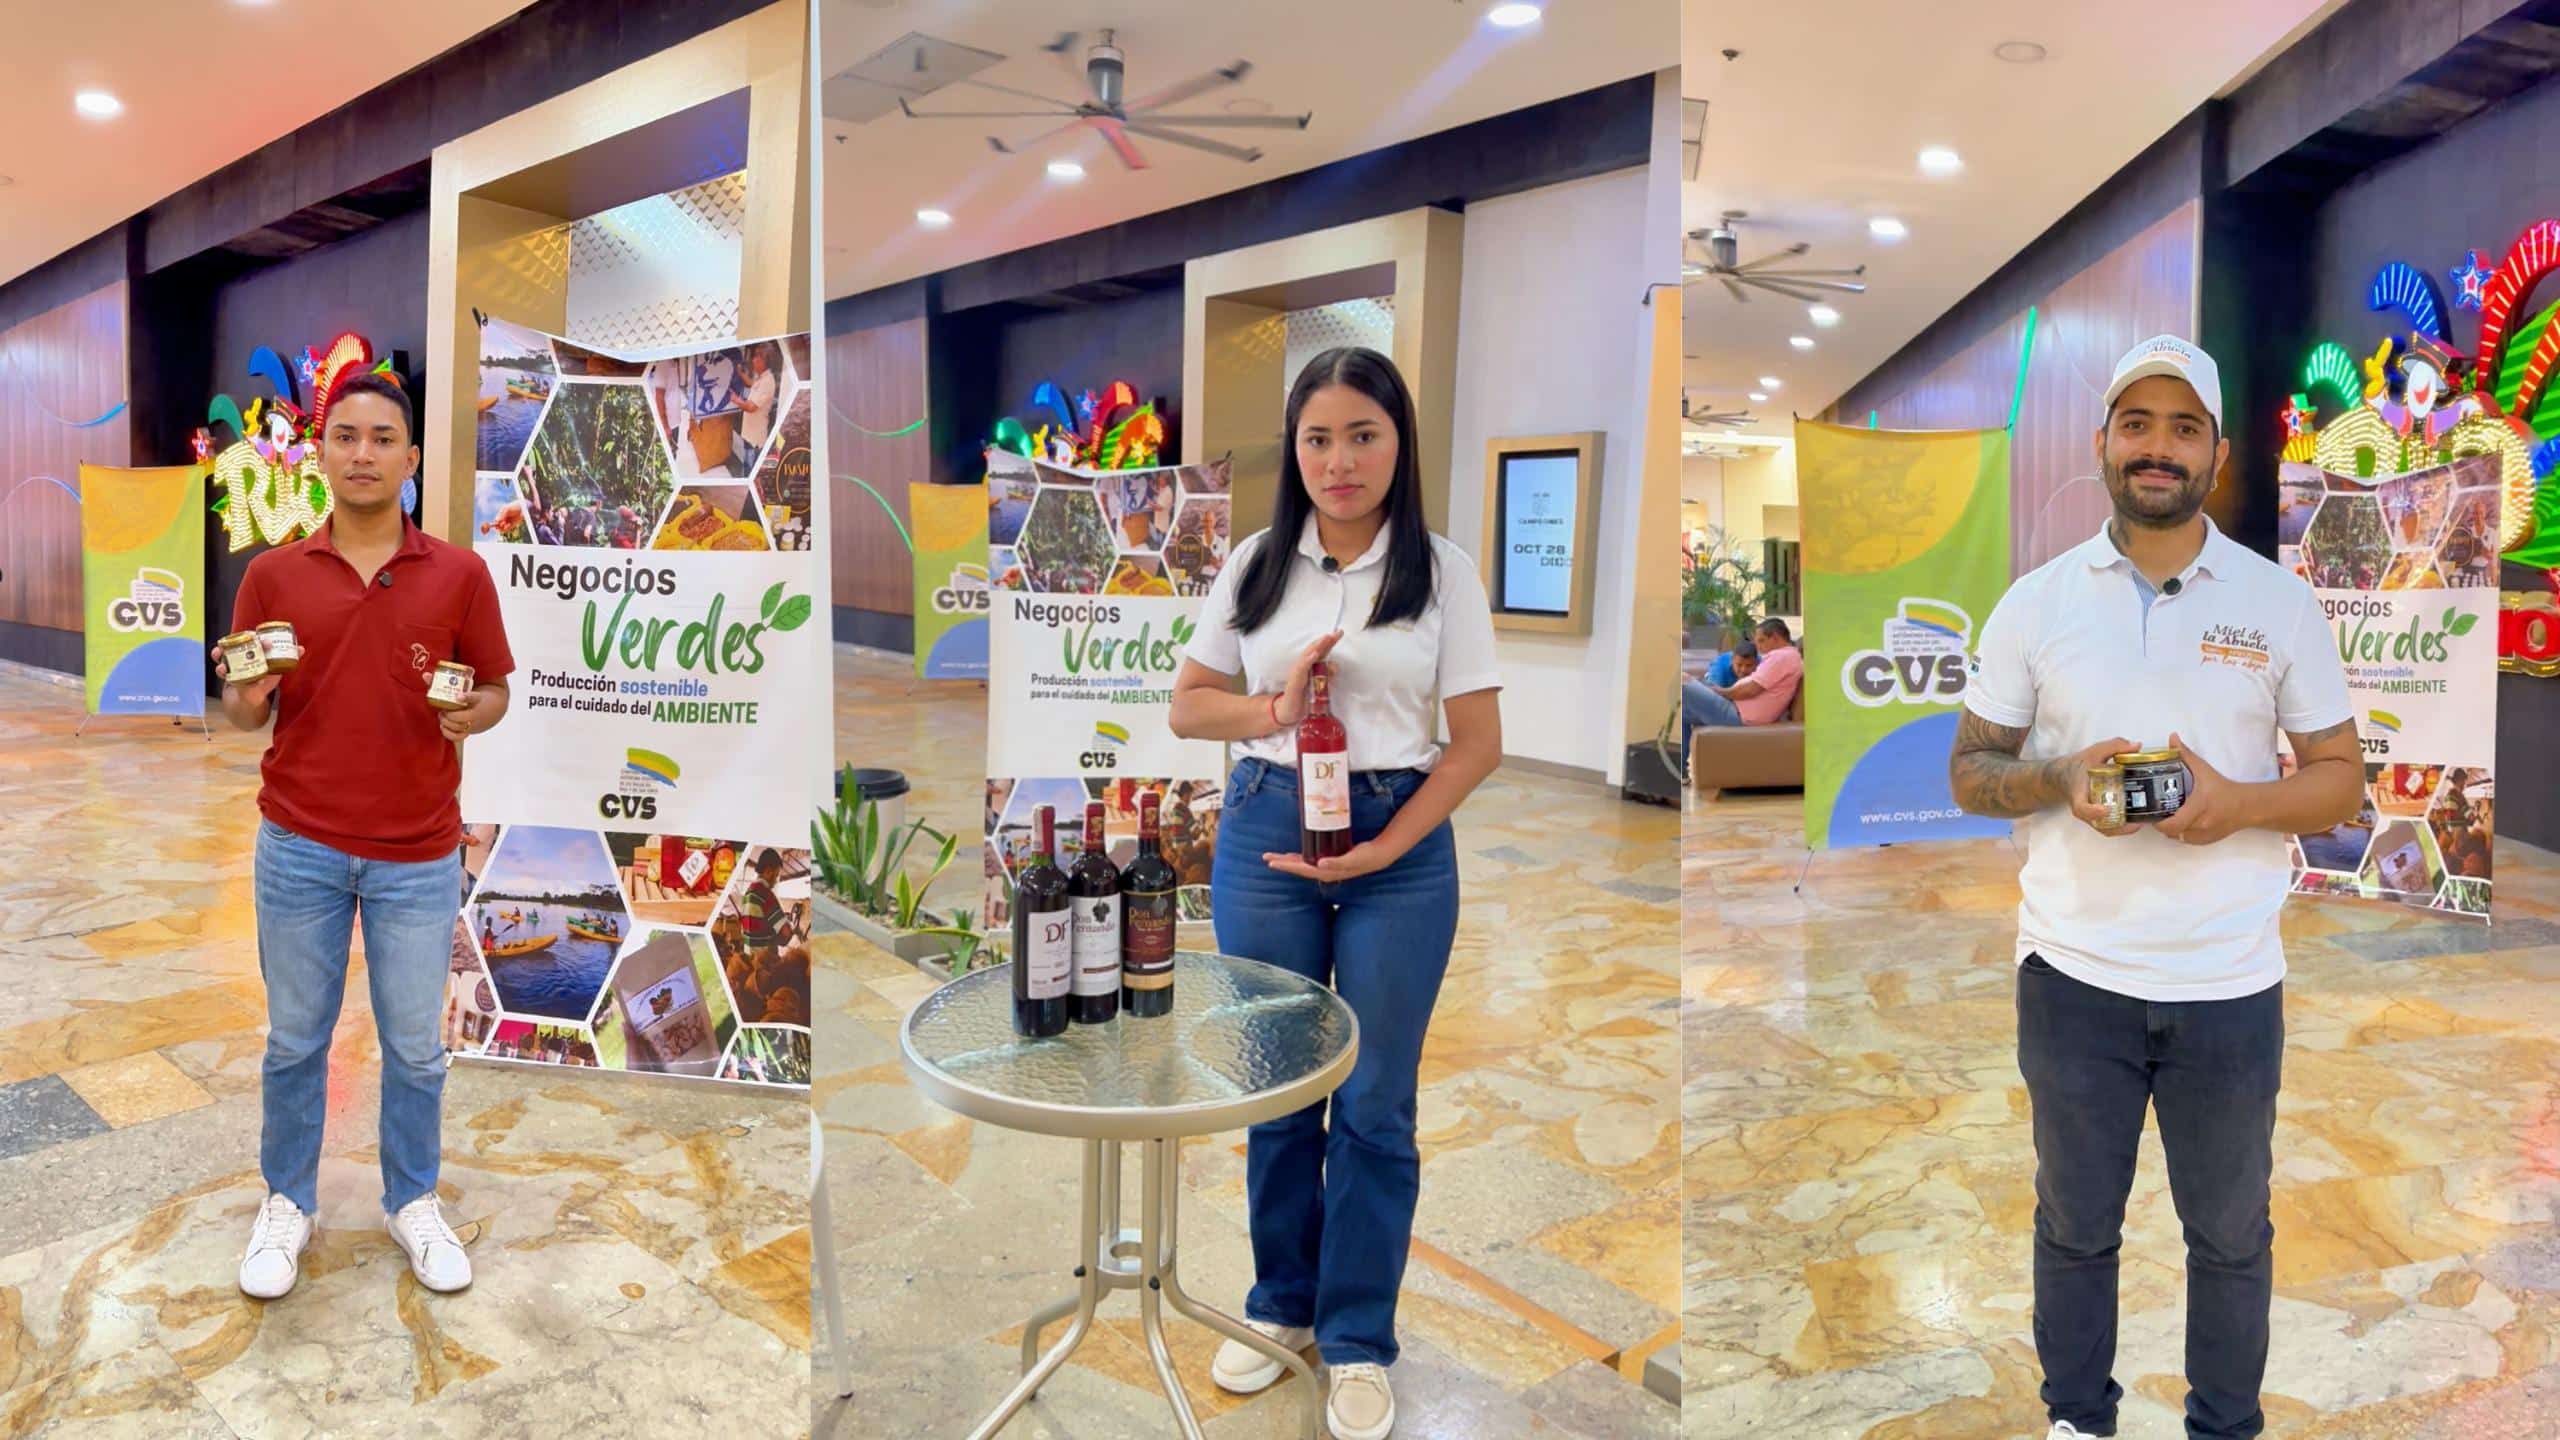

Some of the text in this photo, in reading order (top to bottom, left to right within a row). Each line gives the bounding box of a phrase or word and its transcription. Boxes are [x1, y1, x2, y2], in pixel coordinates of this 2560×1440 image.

[1513, 543, 1566, 555] OCT 28
[510, 554, 677, 600] Negocios
[936, 589, 991, 609] CVS
[2319, 595, 2393, 620] gocios
[115, 601, 182, 627] CVS
[1014, 598, 1121, 628] Negocios
[582, 590, 767, 674] Verdes
[2202, 631, 2268, 651] la Abuela
[2213, 623, 2265, 641] Miel de
[2339, 614, 2449, 663] Verdes
[1064, 621, 1177, 674] Verdes
[531, 669, 708, 697] Producción sostenible
[1031, 673, 1143, 687] Producción sostenible
[1853, 654, 1967, 697] CVS
[2362, 667, 2414, 677] sostenible
[1030, 690, 1050, 701] para
[1051, 690, 1060, 699] el
[1061, 690, 1096, 700] cuidado
[1097, 691, 1110, 700] del
[2368, 680, 2381, 690] del
[2382, 679, 2447, 694] AMBIENTE
[529, 695, 759, 724] para el cuidado del AMBIENTE
[1080, 752, 1117, 769] CVS
[598, 793, 657, 820] CVS
[1860, 808, 1963, 825] www.cvs.gov.co
